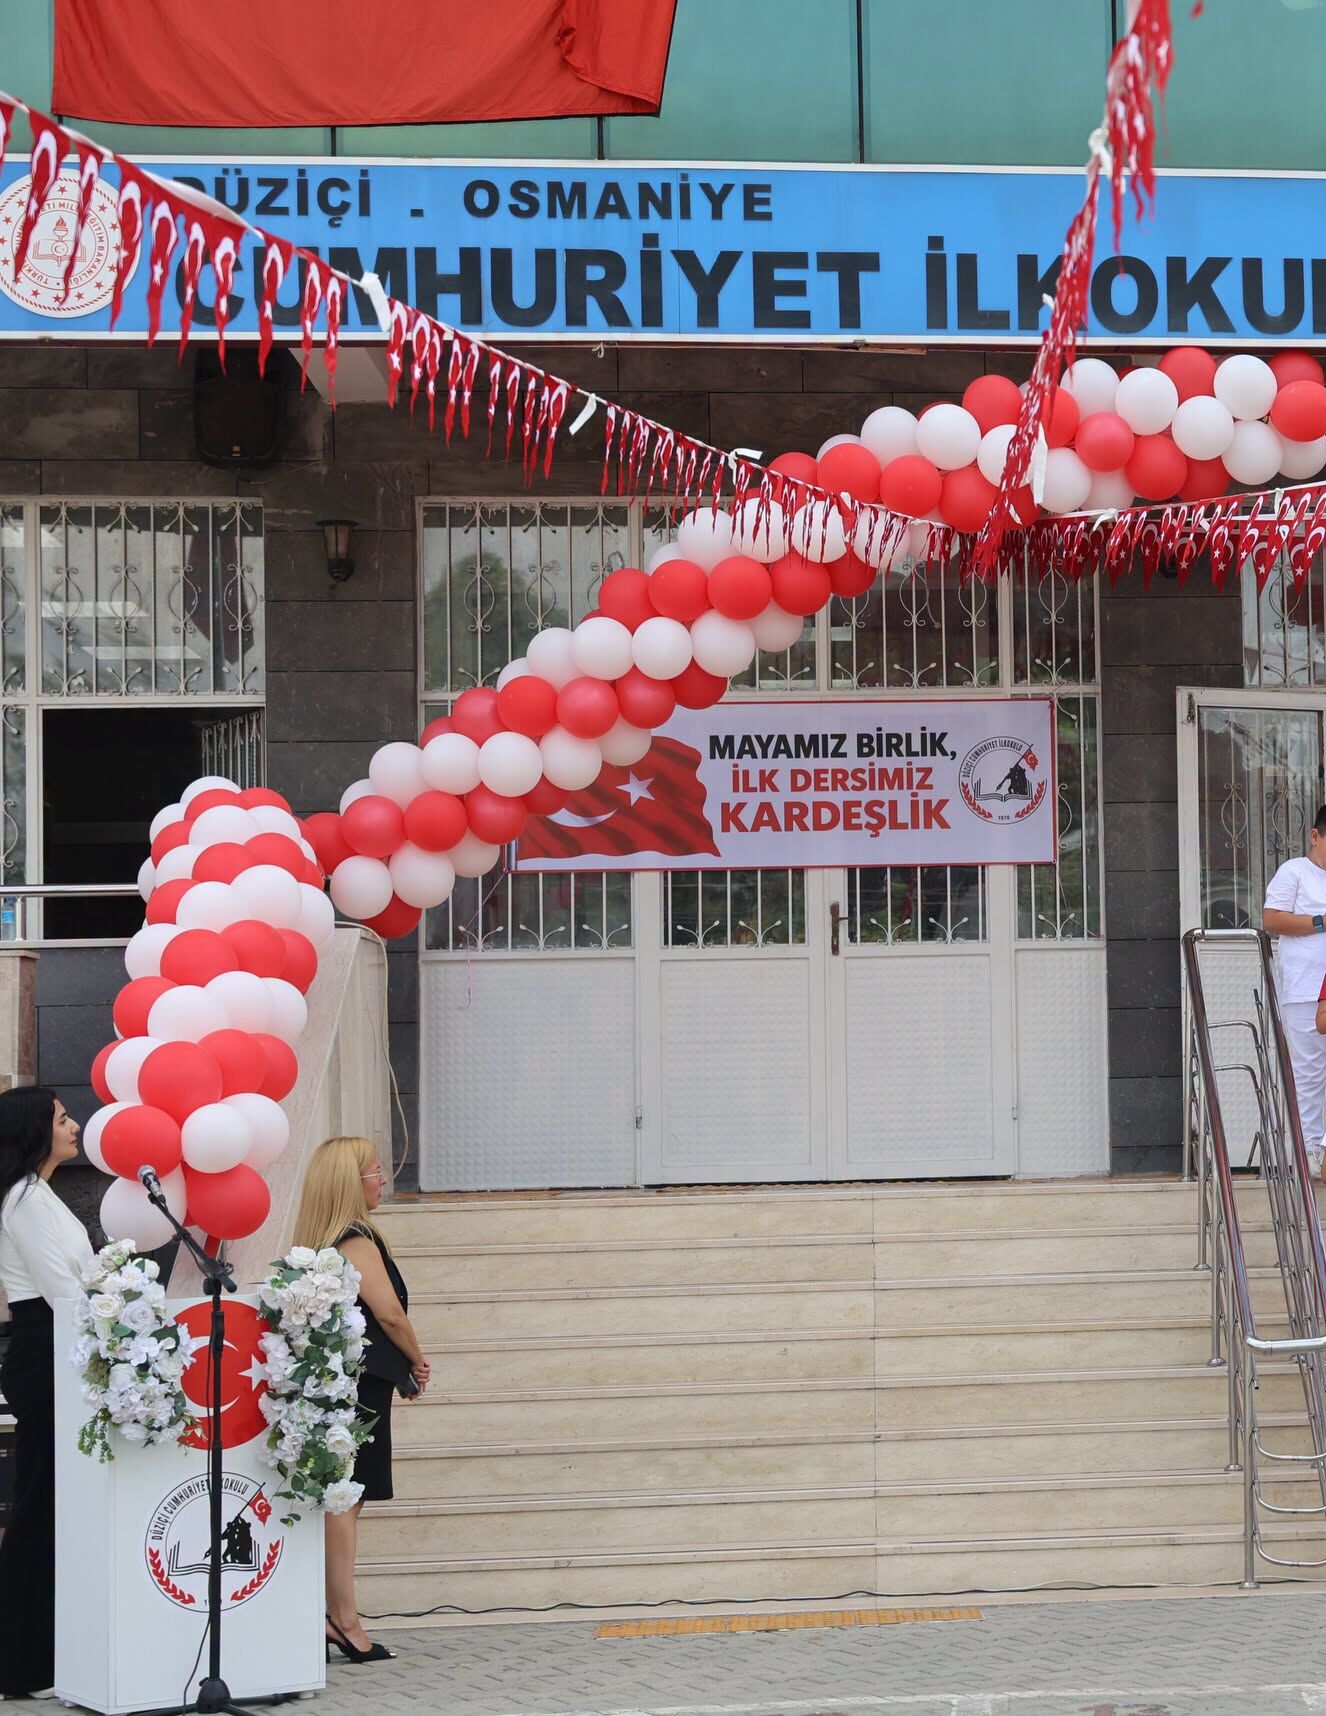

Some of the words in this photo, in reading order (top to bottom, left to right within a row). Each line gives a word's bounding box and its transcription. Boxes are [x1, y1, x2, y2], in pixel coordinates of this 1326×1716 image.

[462, 172, 773, 222] OSMANİYE
[174, 232, 881, 330] CUMHURİYET
[709, 733, 847, 760] MAYAMIZ
[856, 726, 957, 760] BİRLİK,
[732, 763, 780, 793] İLK
[790, 761, 934, 793] DERSİMİZ
[720, 791, 952, 838] KARDEŞLİK
[149, 1512, 171, 1541] DÜZİÇİ
